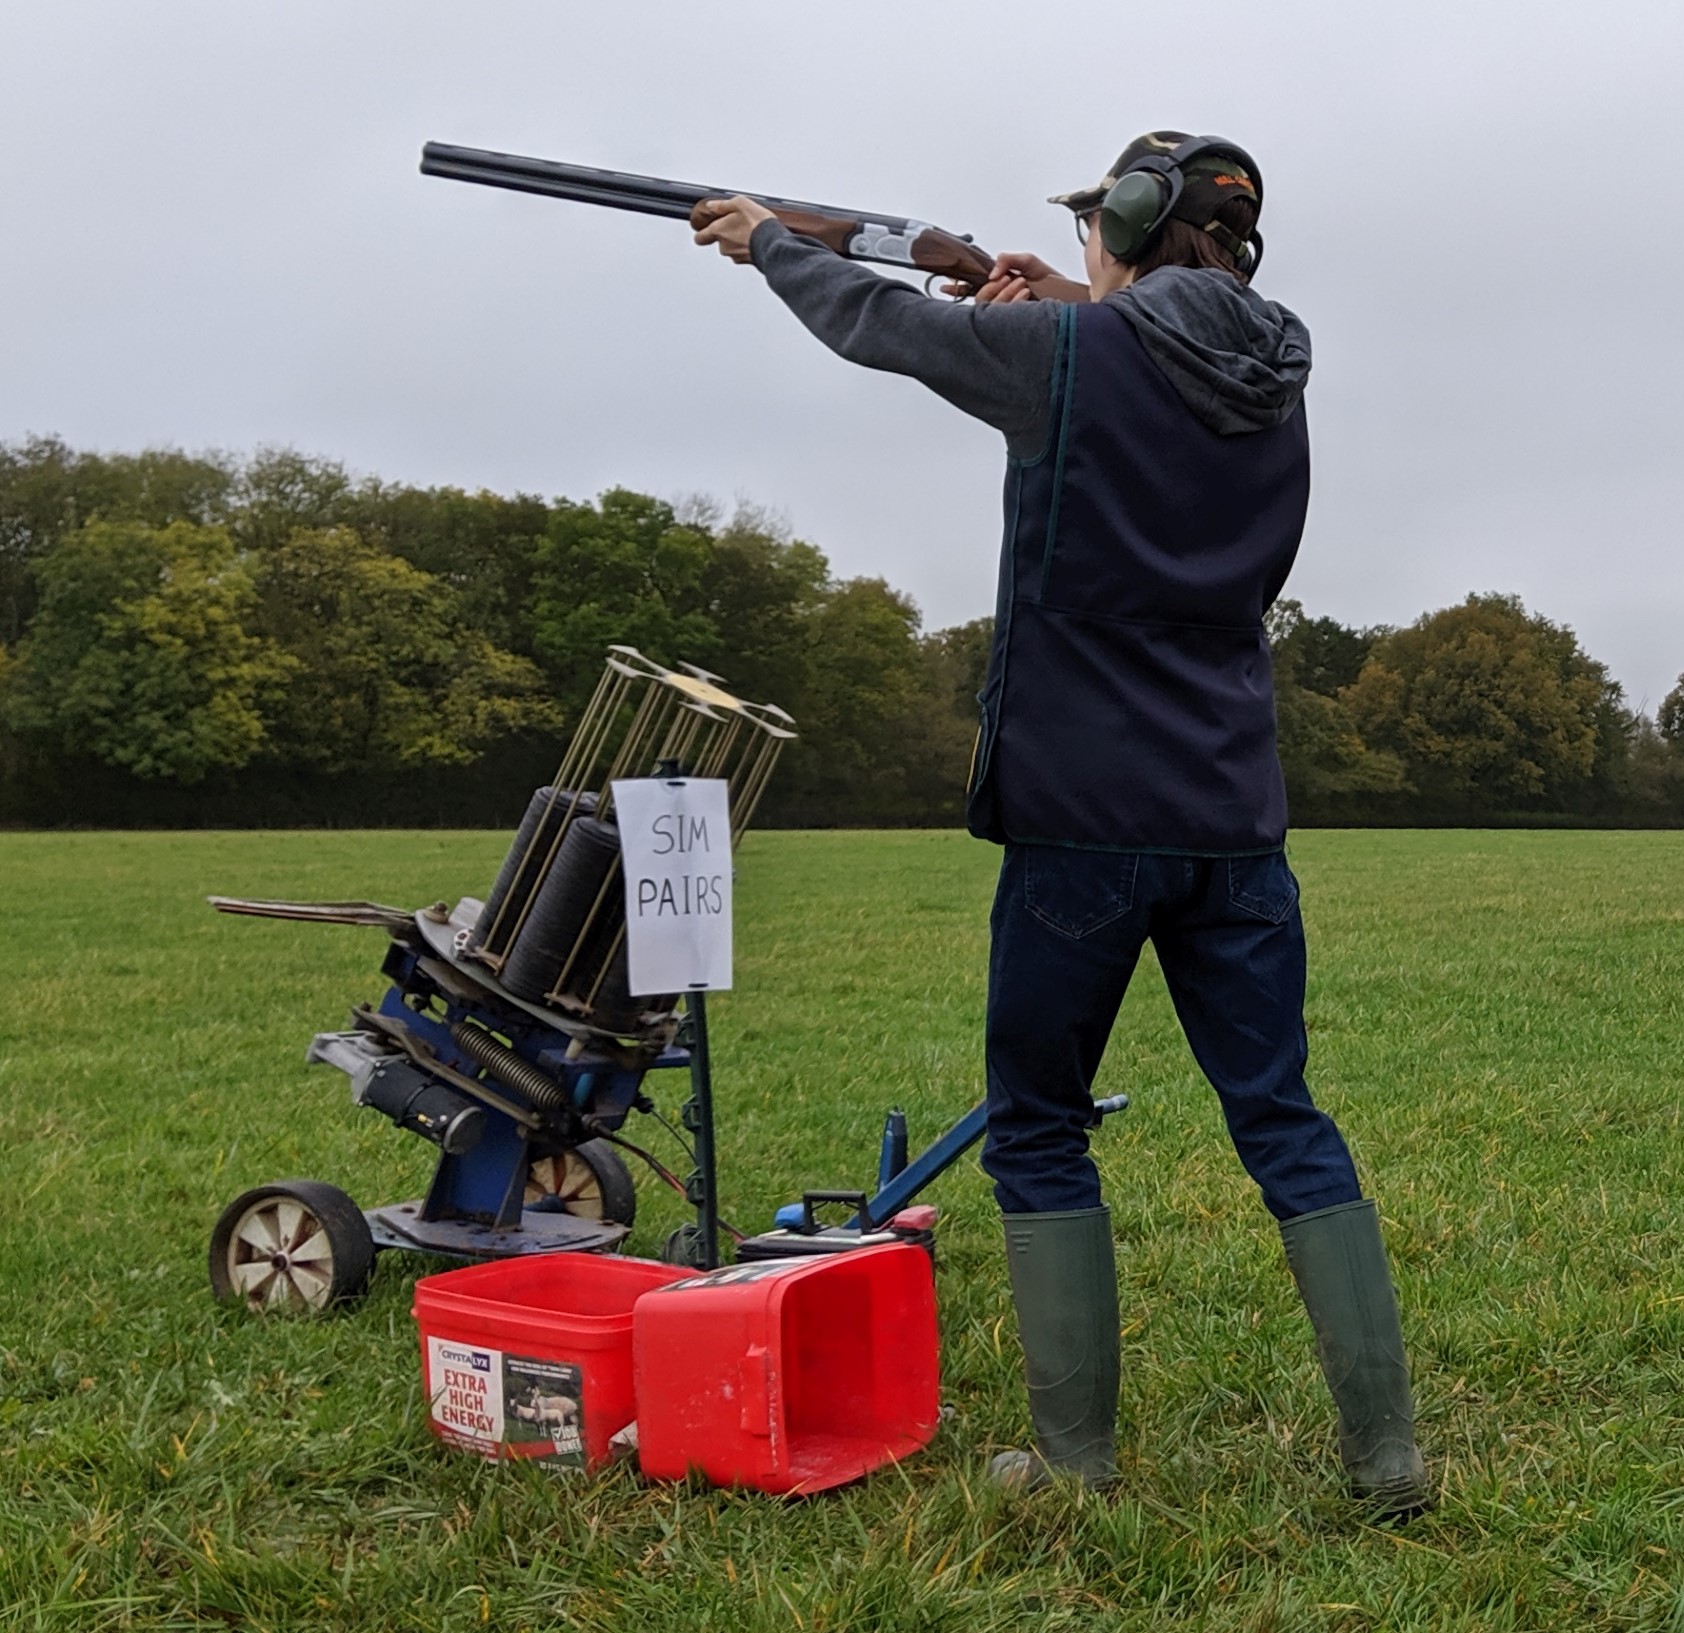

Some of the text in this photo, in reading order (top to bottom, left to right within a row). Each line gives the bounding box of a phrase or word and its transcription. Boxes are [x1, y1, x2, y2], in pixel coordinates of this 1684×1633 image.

[652, 814, 710, 855] SIM
[638, 875, 722, 917] PAIRS
[444, 1369, 487, 1394] EXTRA
[449, 1388, 483, 1412] HIGH
[441, 1405, 494, 1432] ENERGY
